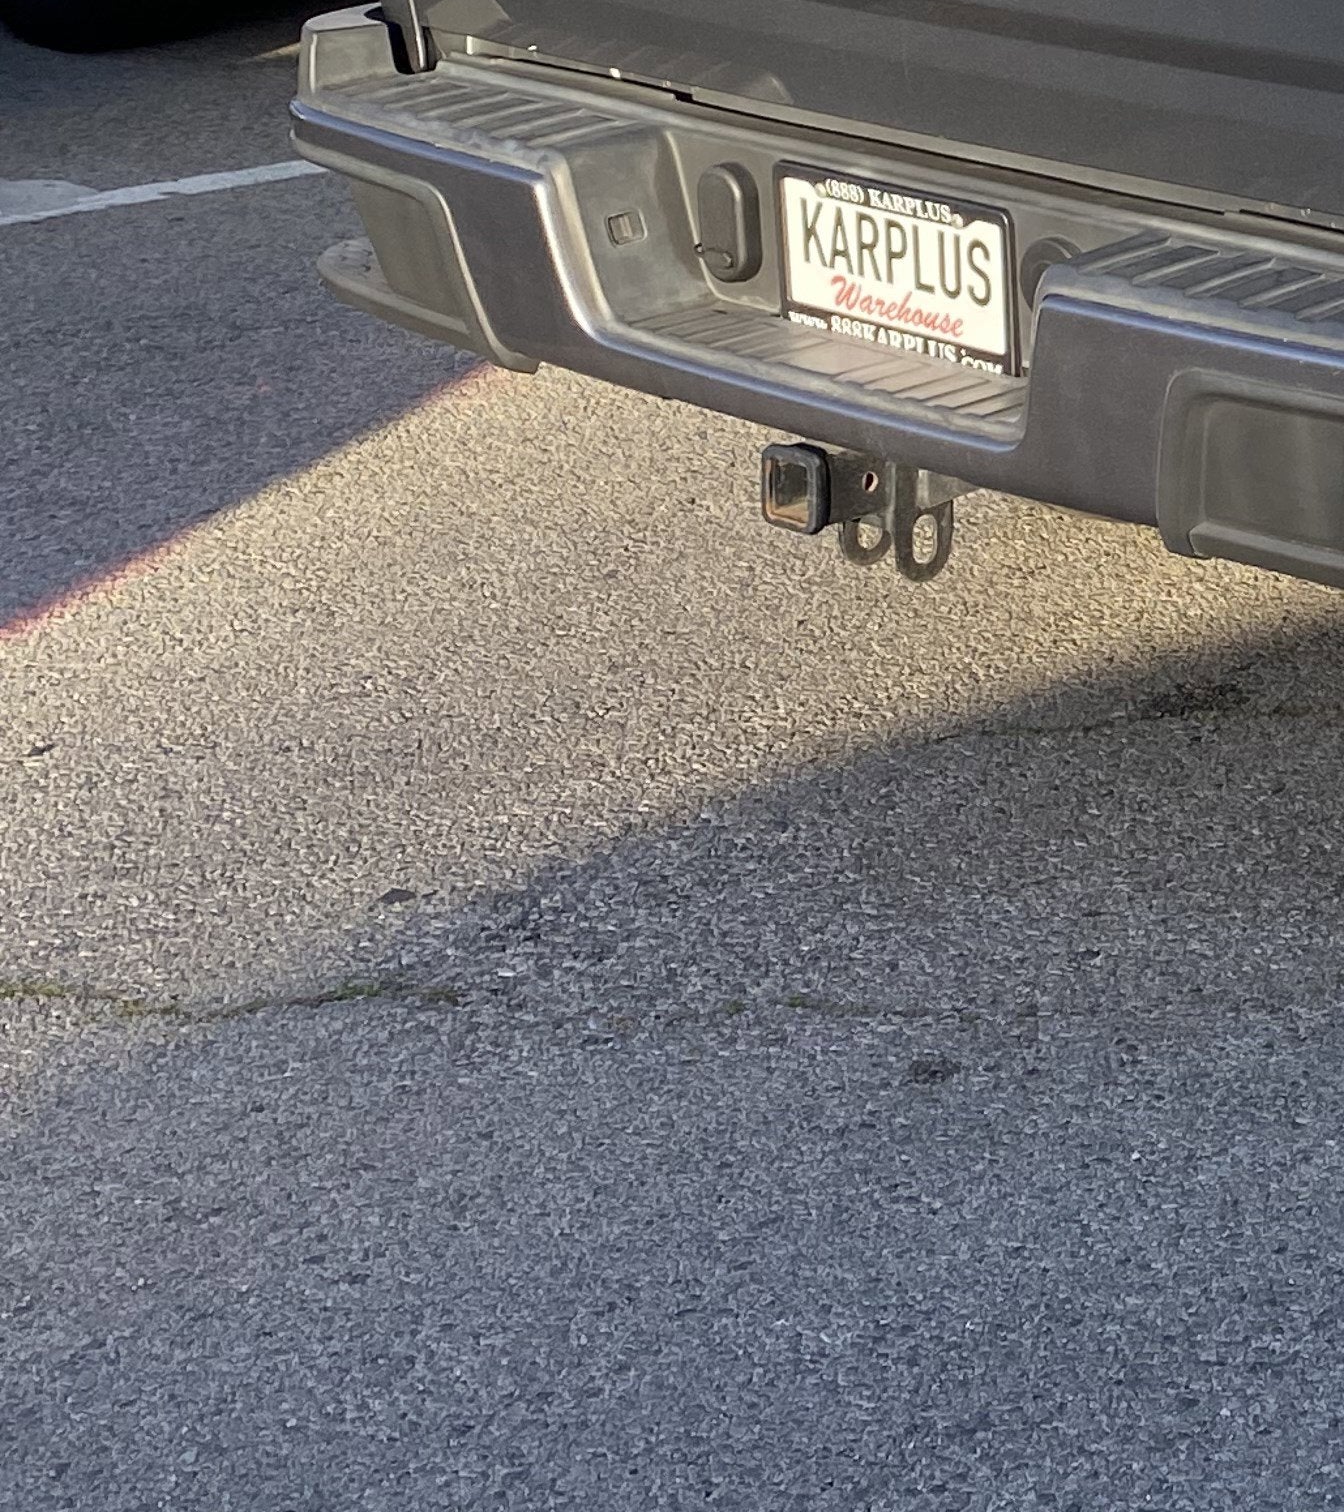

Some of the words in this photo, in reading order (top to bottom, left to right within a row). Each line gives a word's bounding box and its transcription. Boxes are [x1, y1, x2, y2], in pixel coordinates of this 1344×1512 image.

[825, 178, 865, 204] (888)
[867, 188, 952, 224] KARPLUS
[800, 197, 992, 307] KARPLUS
[830, 275, 963, 338] Warehouse
